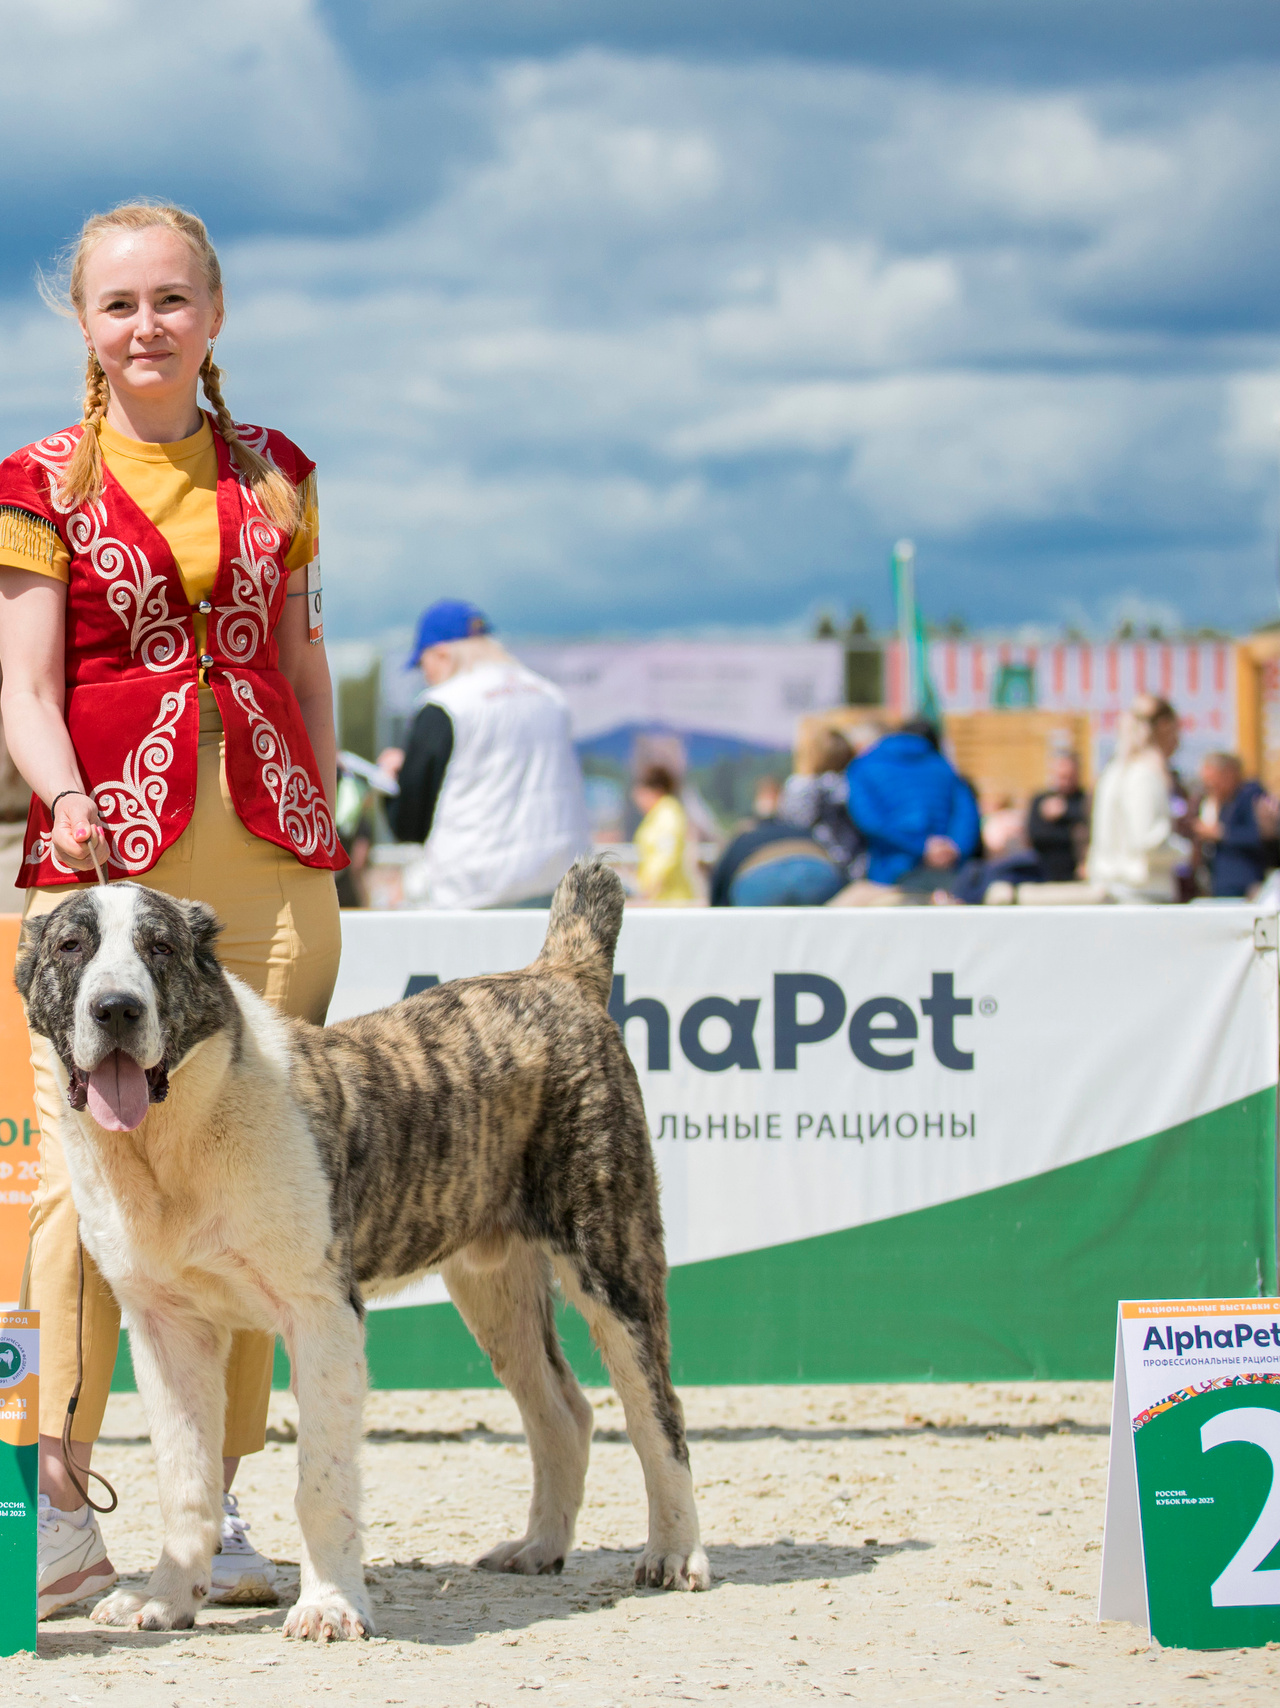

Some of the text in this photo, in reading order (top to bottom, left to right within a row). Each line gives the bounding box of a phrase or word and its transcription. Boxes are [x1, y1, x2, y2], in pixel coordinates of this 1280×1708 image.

[797, 1111, 977, 1143] РАЦИОНЫ
[1138, 1305, 1217, 1314] НАЦИОНАЛЬНЫЕ
[1220, 1303, 1270, 1311] ВЫСТАВКИ
[1143, 1355, 1280, 1367] ПРОФЕССИОНАЛЬНЫЕ РАЦИОН
[16, 1398, 27, 1408] 11
[1200, 1406, 1280, 1607] 2
[9, 1509, 26, 1517] 2023
